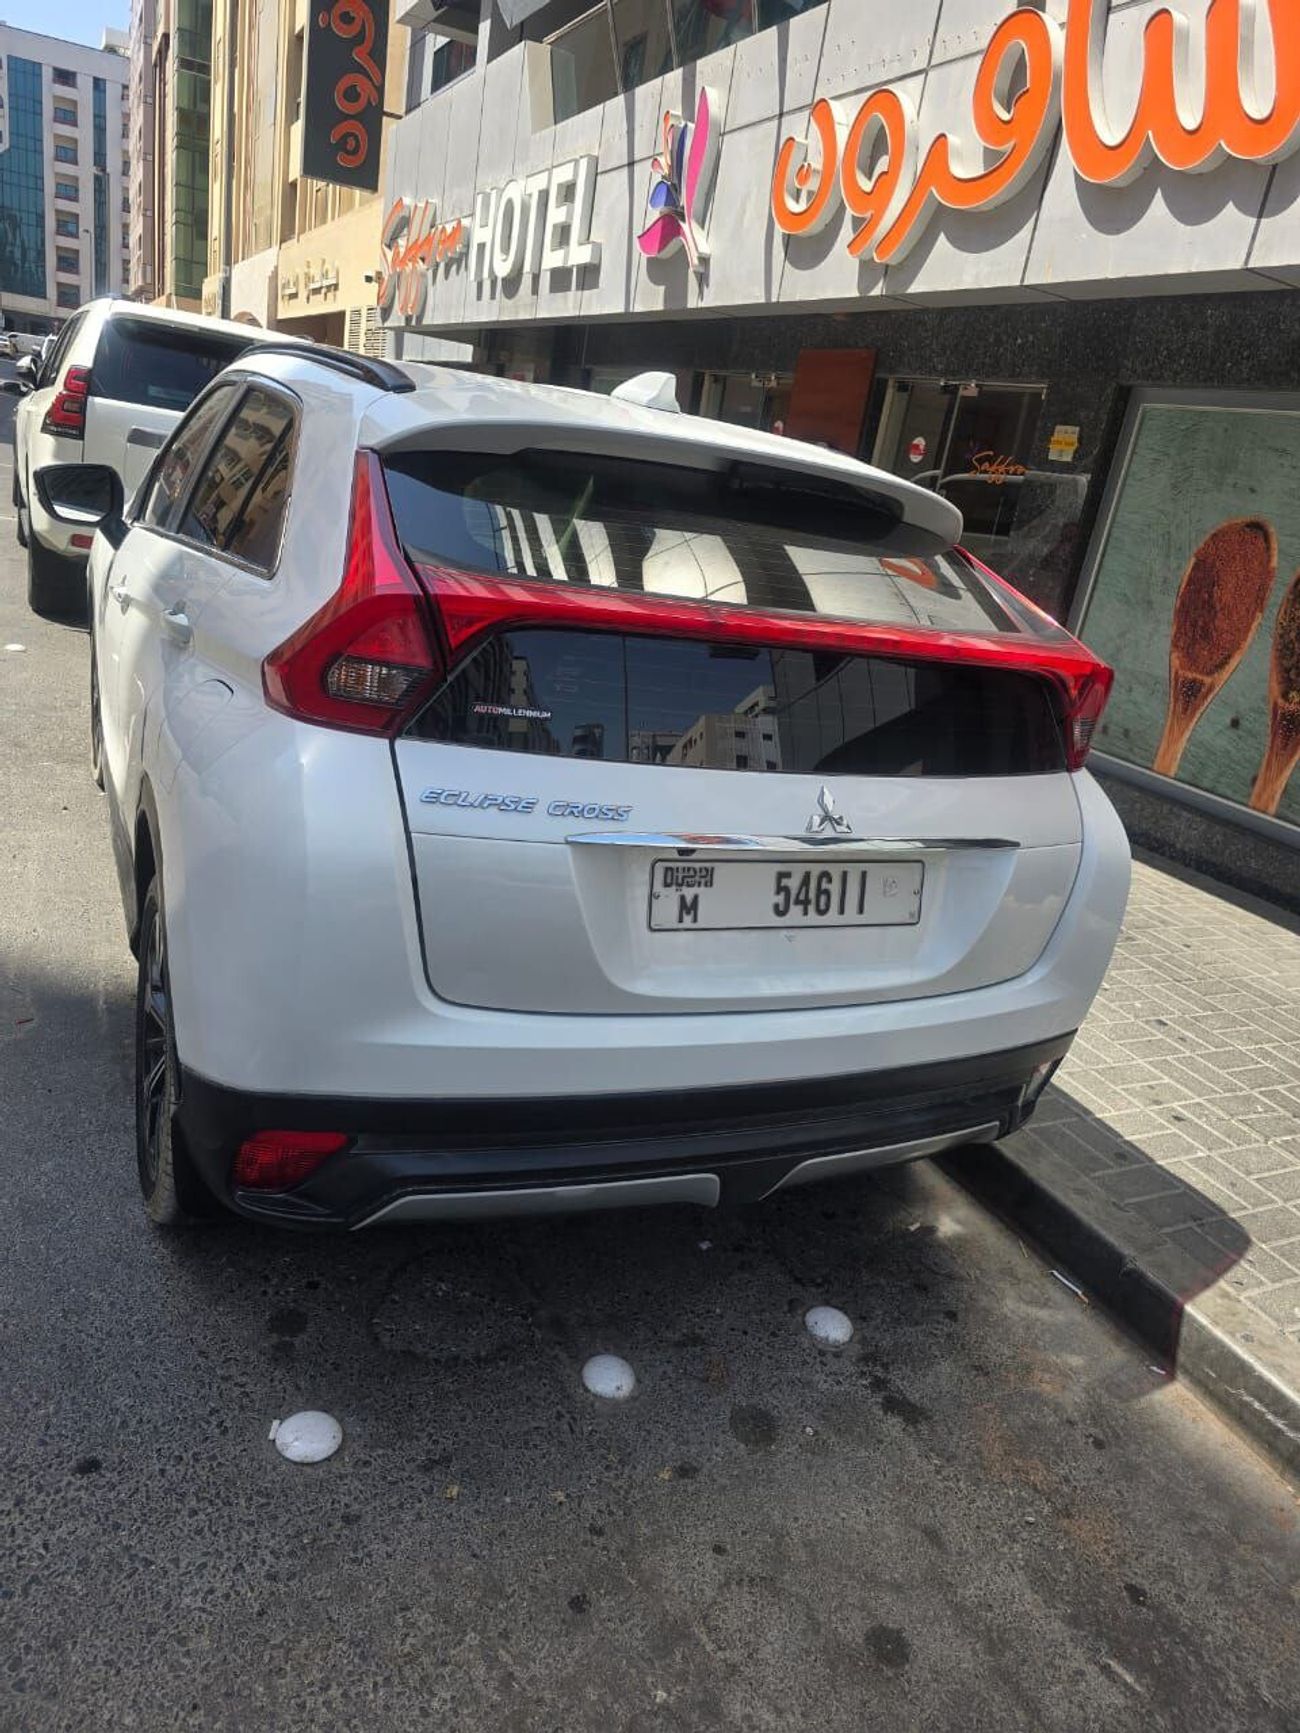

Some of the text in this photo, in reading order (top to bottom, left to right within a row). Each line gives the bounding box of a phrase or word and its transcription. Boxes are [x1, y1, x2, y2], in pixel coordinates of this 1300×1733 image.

[468, 153, 602, 283] HOTEL
[419, 785, 634, 822] ECLIPSE CROSS
[677, 893, 700, 924] M
[772, 870, 868, 917] 54611
